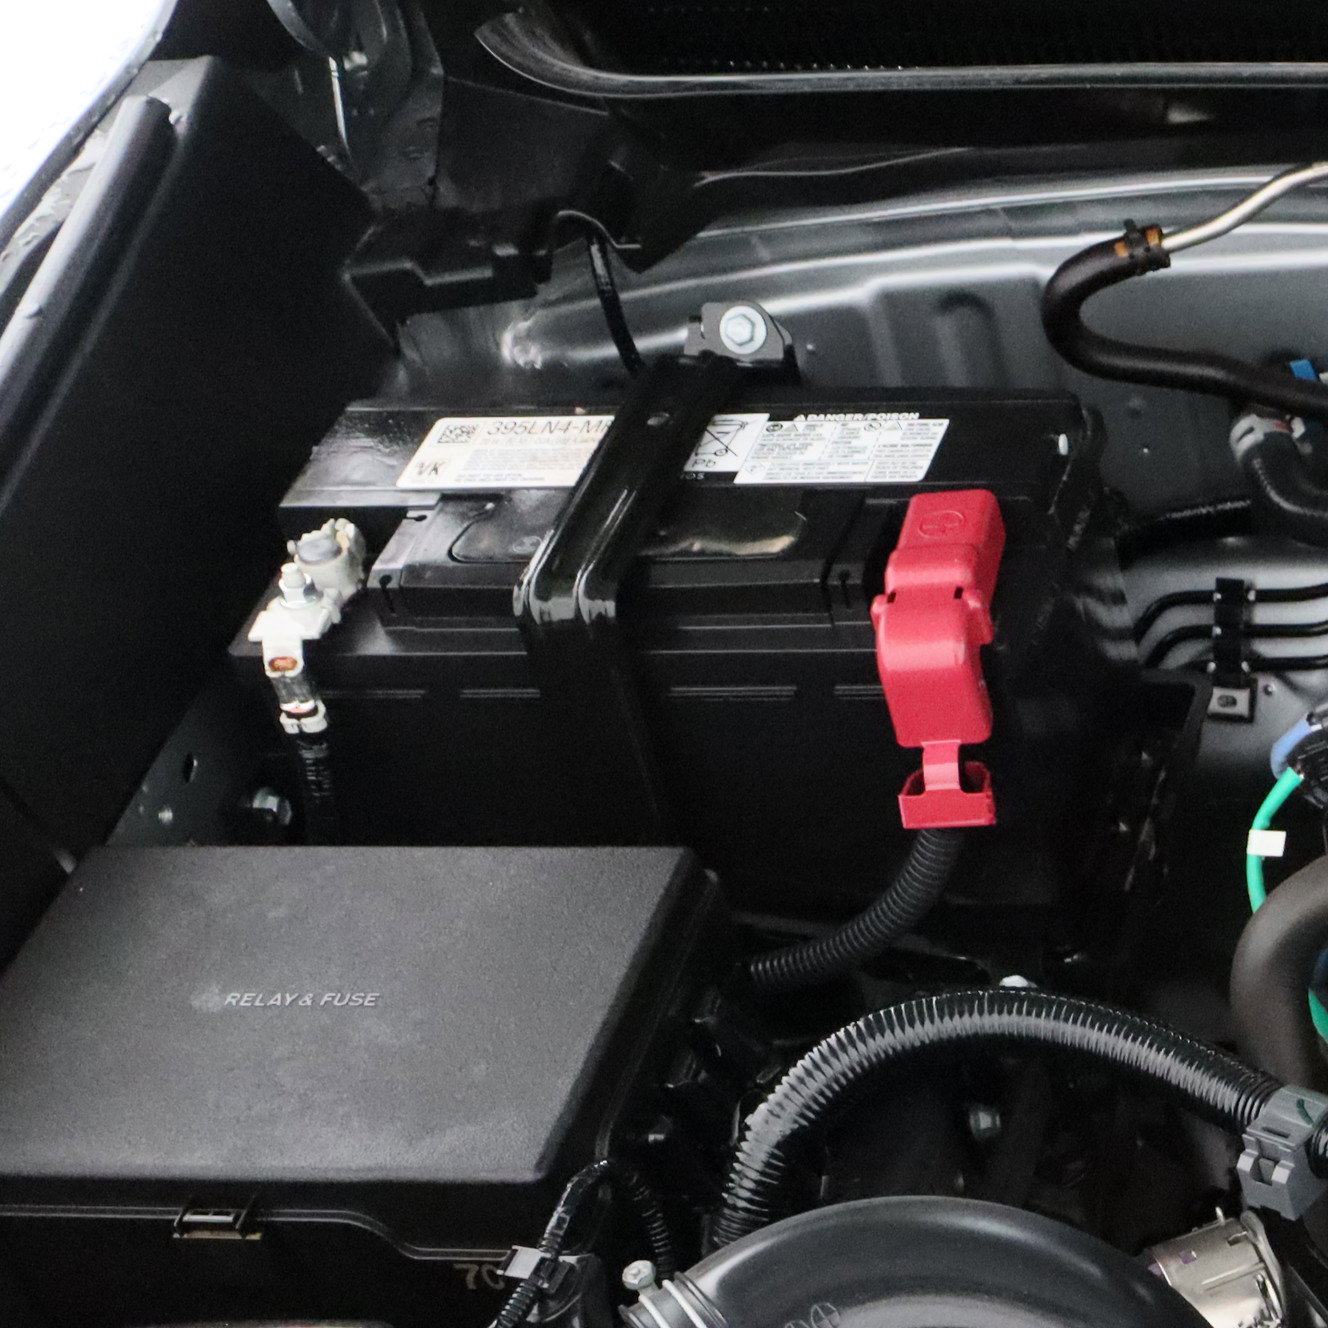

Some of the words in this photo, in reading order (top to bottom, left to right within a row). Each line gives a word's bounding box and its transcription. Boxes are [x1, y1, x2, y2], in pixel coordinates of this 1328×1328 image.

[691, 458, 717, 469] Pb
[224, 992, 299, 1006] RELAY
[299, 992, 314, 1006] &
[319, 992, 380, 1006] FUSE
